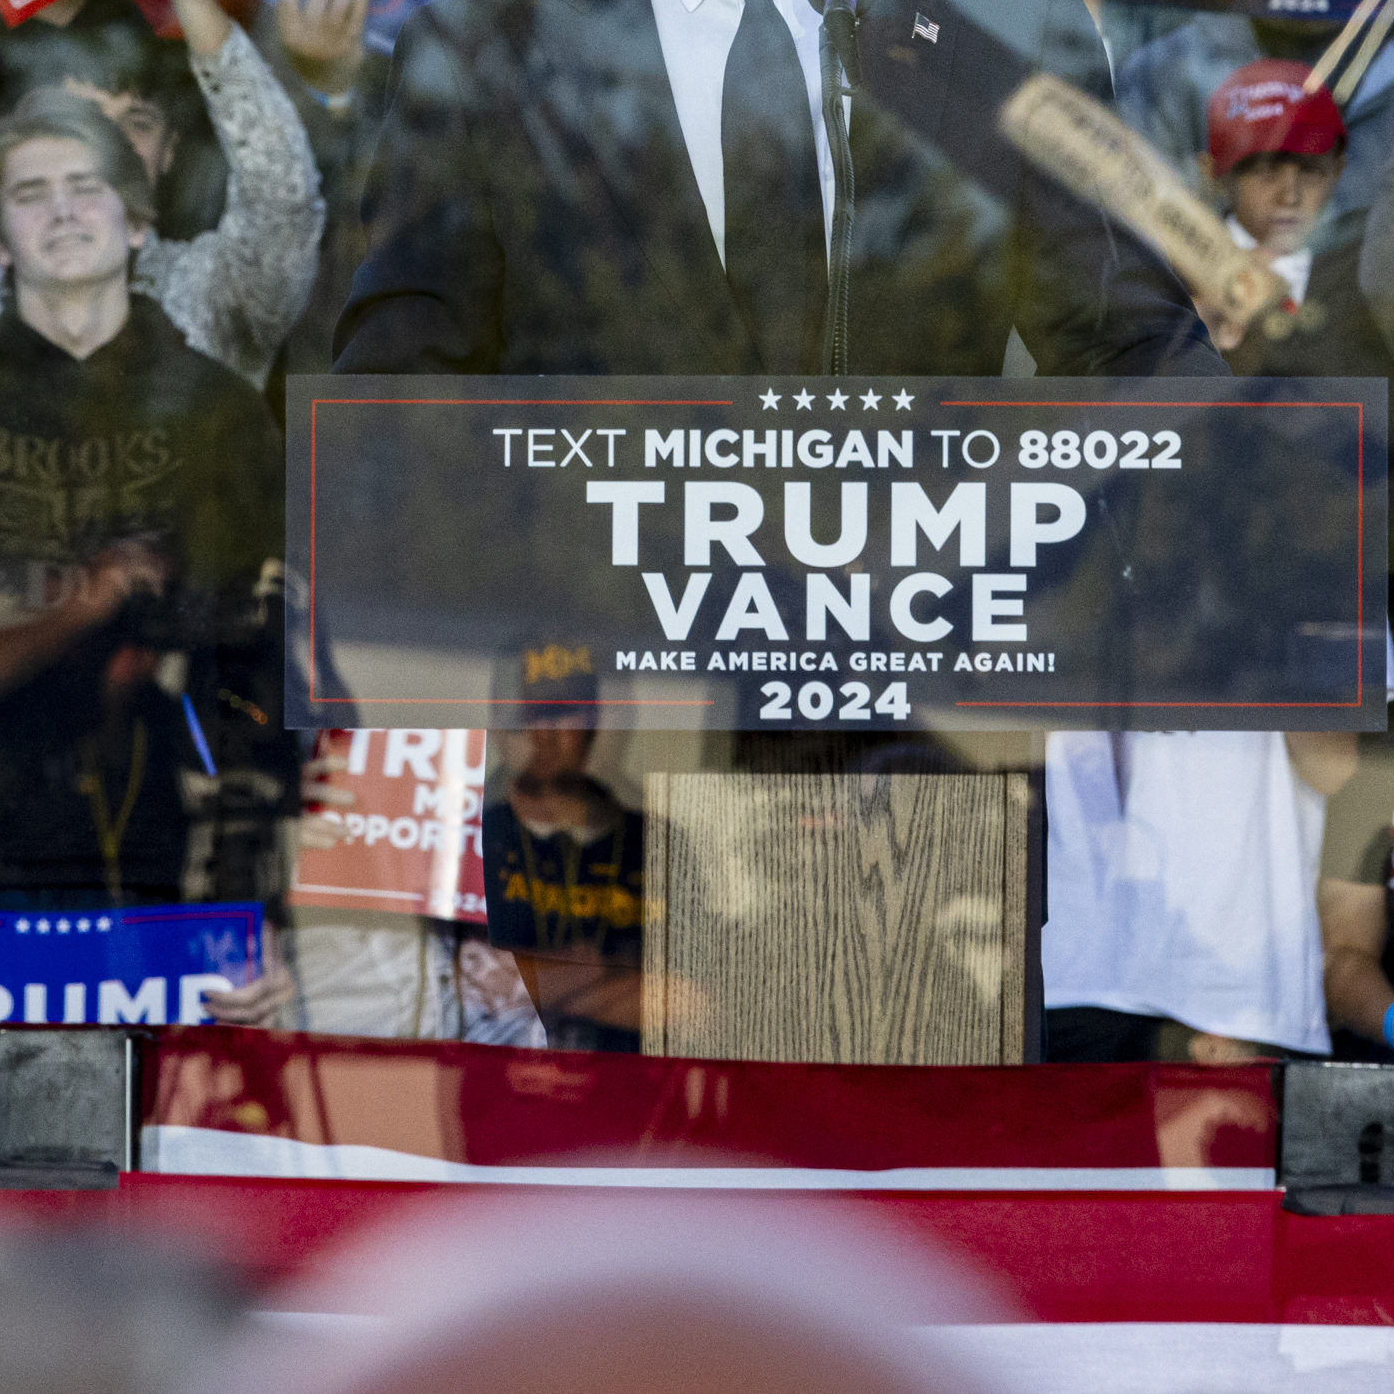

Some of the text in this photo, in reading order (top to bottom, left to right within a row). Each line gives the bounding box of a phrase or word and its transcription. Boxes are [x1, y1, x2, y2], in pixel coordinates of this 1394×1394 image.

[493, 429, 1183, 469] TEXT MICHIGAN TO 88022
[586, 481, 1086, 568] TRUMP
[641, 572, 1028, 643] VANCE
[615, 651, 697, 672] MAKE
[707, 651, 840, 672] AMERICA
[848, 652, 944, 673] GREAT
[953, 652, 1056, 673] AGAIN!
[759, 680, 911, 721] 2024
[344, 729, 485, 787] TRU
